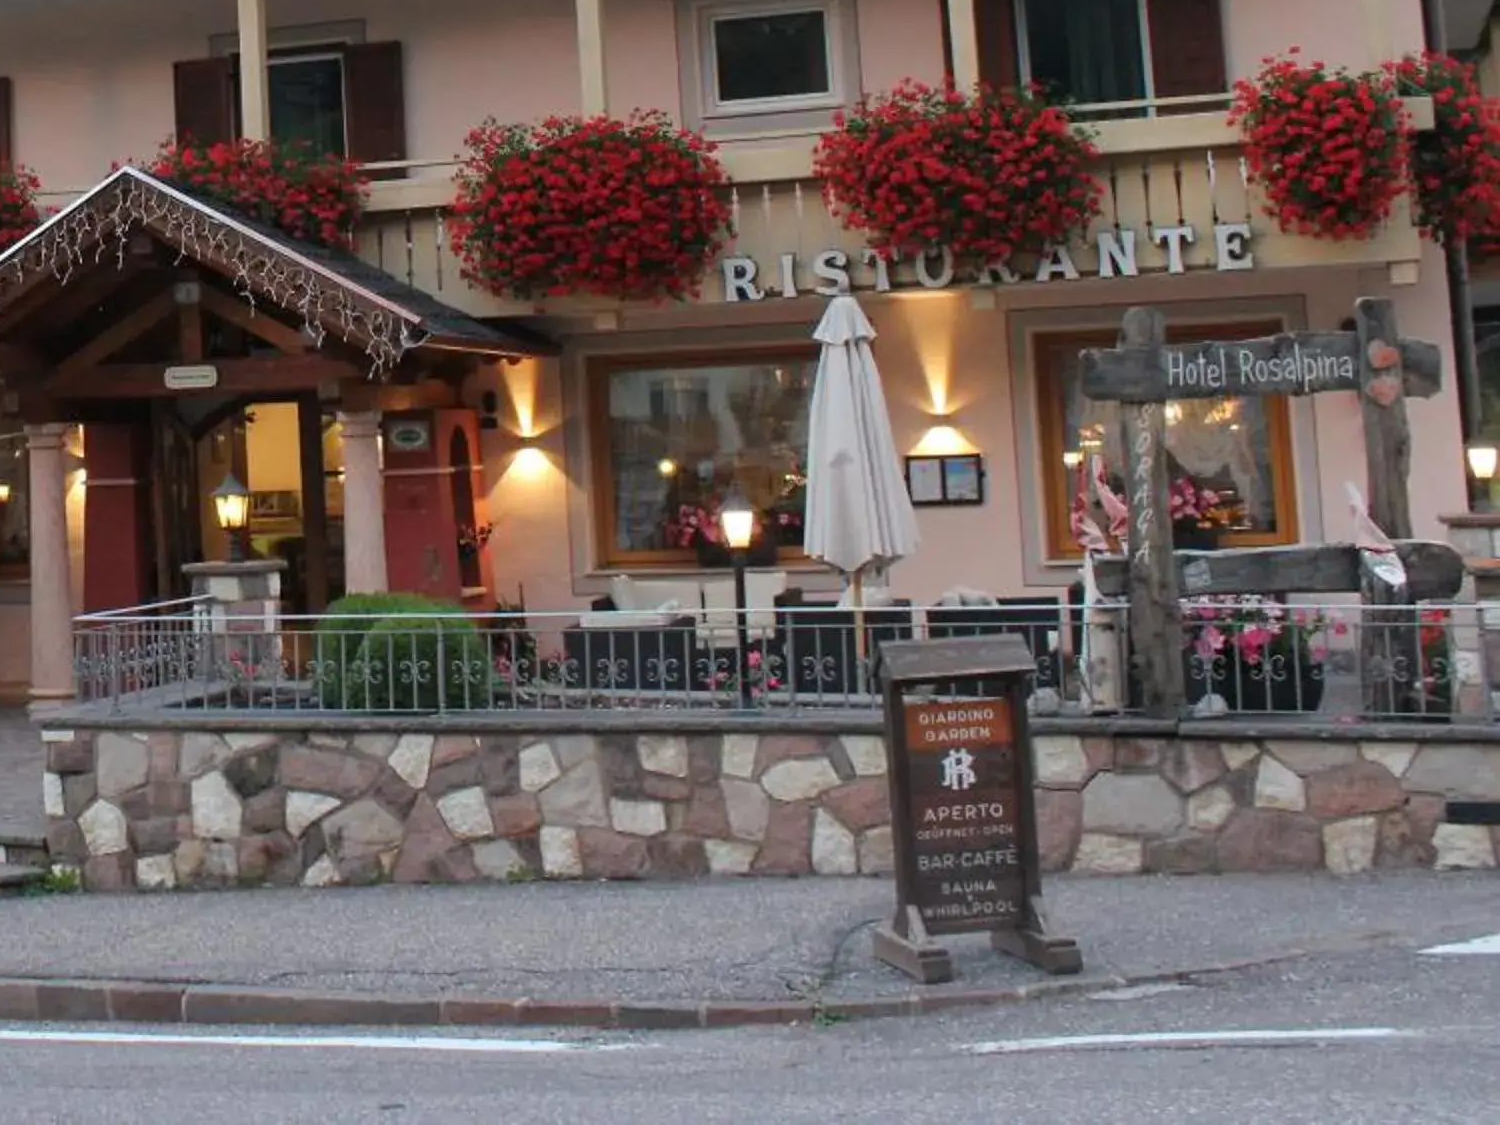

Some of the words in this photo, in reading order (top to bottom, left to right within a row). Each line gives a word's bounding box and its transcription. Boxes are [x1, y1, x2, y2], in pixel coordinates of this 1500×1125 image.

[1166, 347, 1227, 388] Hotel
[1238, 342, 1354, 394] Rosalpina
[918, 708, 994, 725] GIARDINO
[925, 726, 991, 743] GARDEN
[923, 802, 1004, 822] APERTO
[941, 879, 997, 895] SAUNA
[921, 900, 1019, 918] WHIRLPOOL
